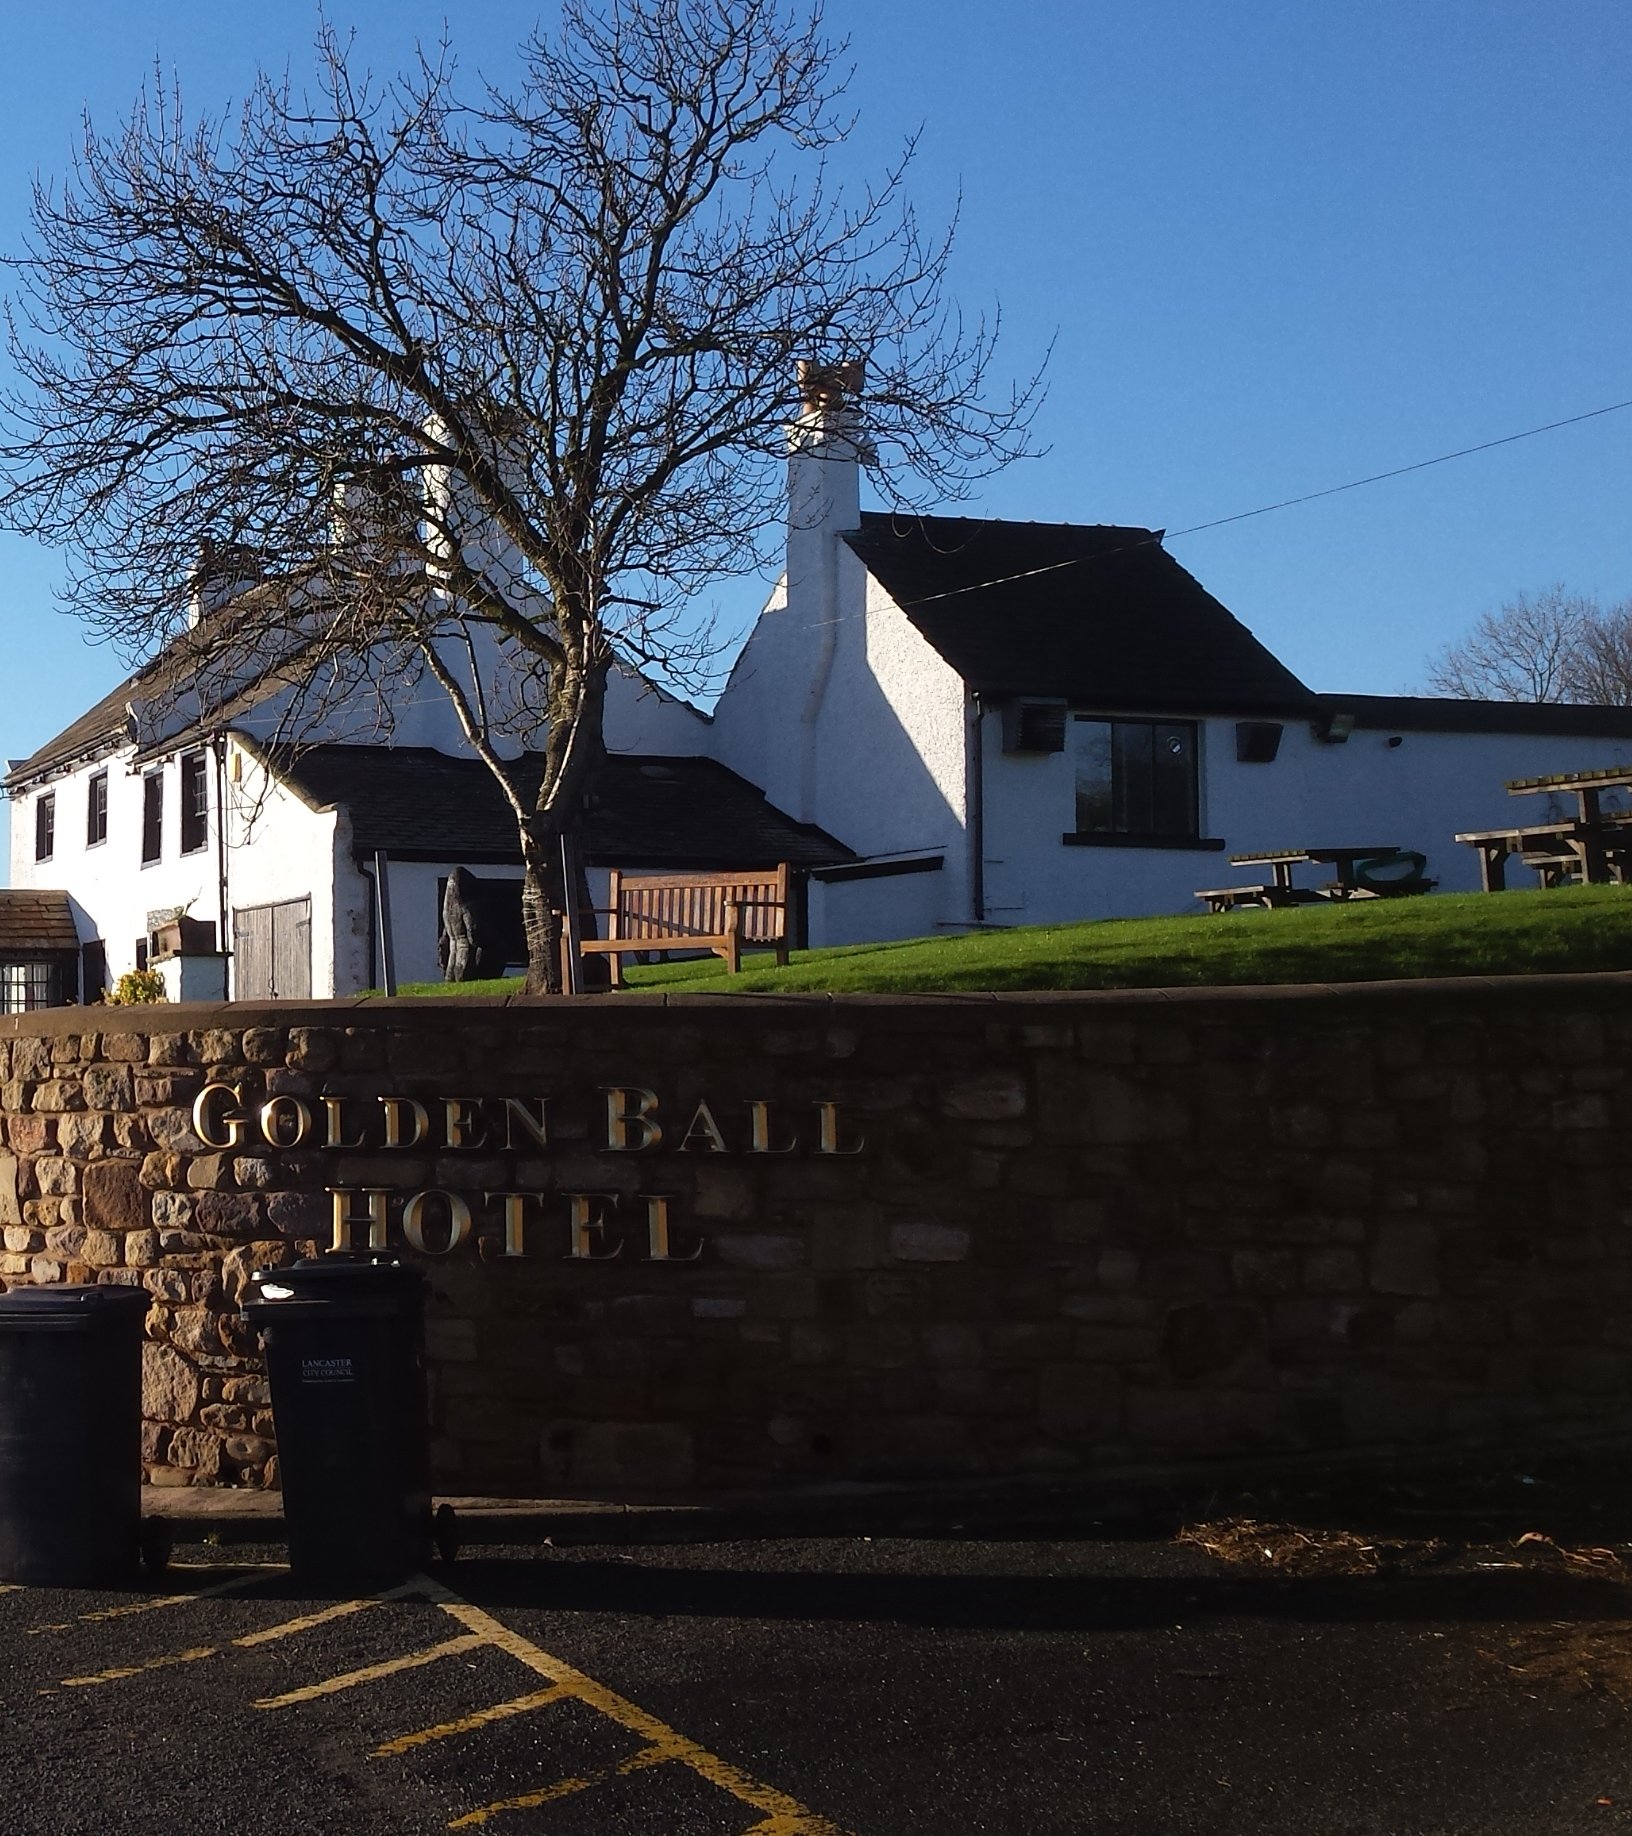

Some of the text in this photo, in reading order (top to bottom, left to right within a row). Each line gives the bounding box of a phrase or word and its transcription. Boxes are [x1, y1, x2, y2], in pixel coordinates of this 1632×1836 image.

[192, 1081, 866, 1155] GOLDEN BALL
[324, 1187, 704, 1262] HOTEL
[301, 1359, 353, 1368] LANCASTER
[302, 1369, 353, 1377] CITY COUNCIL
